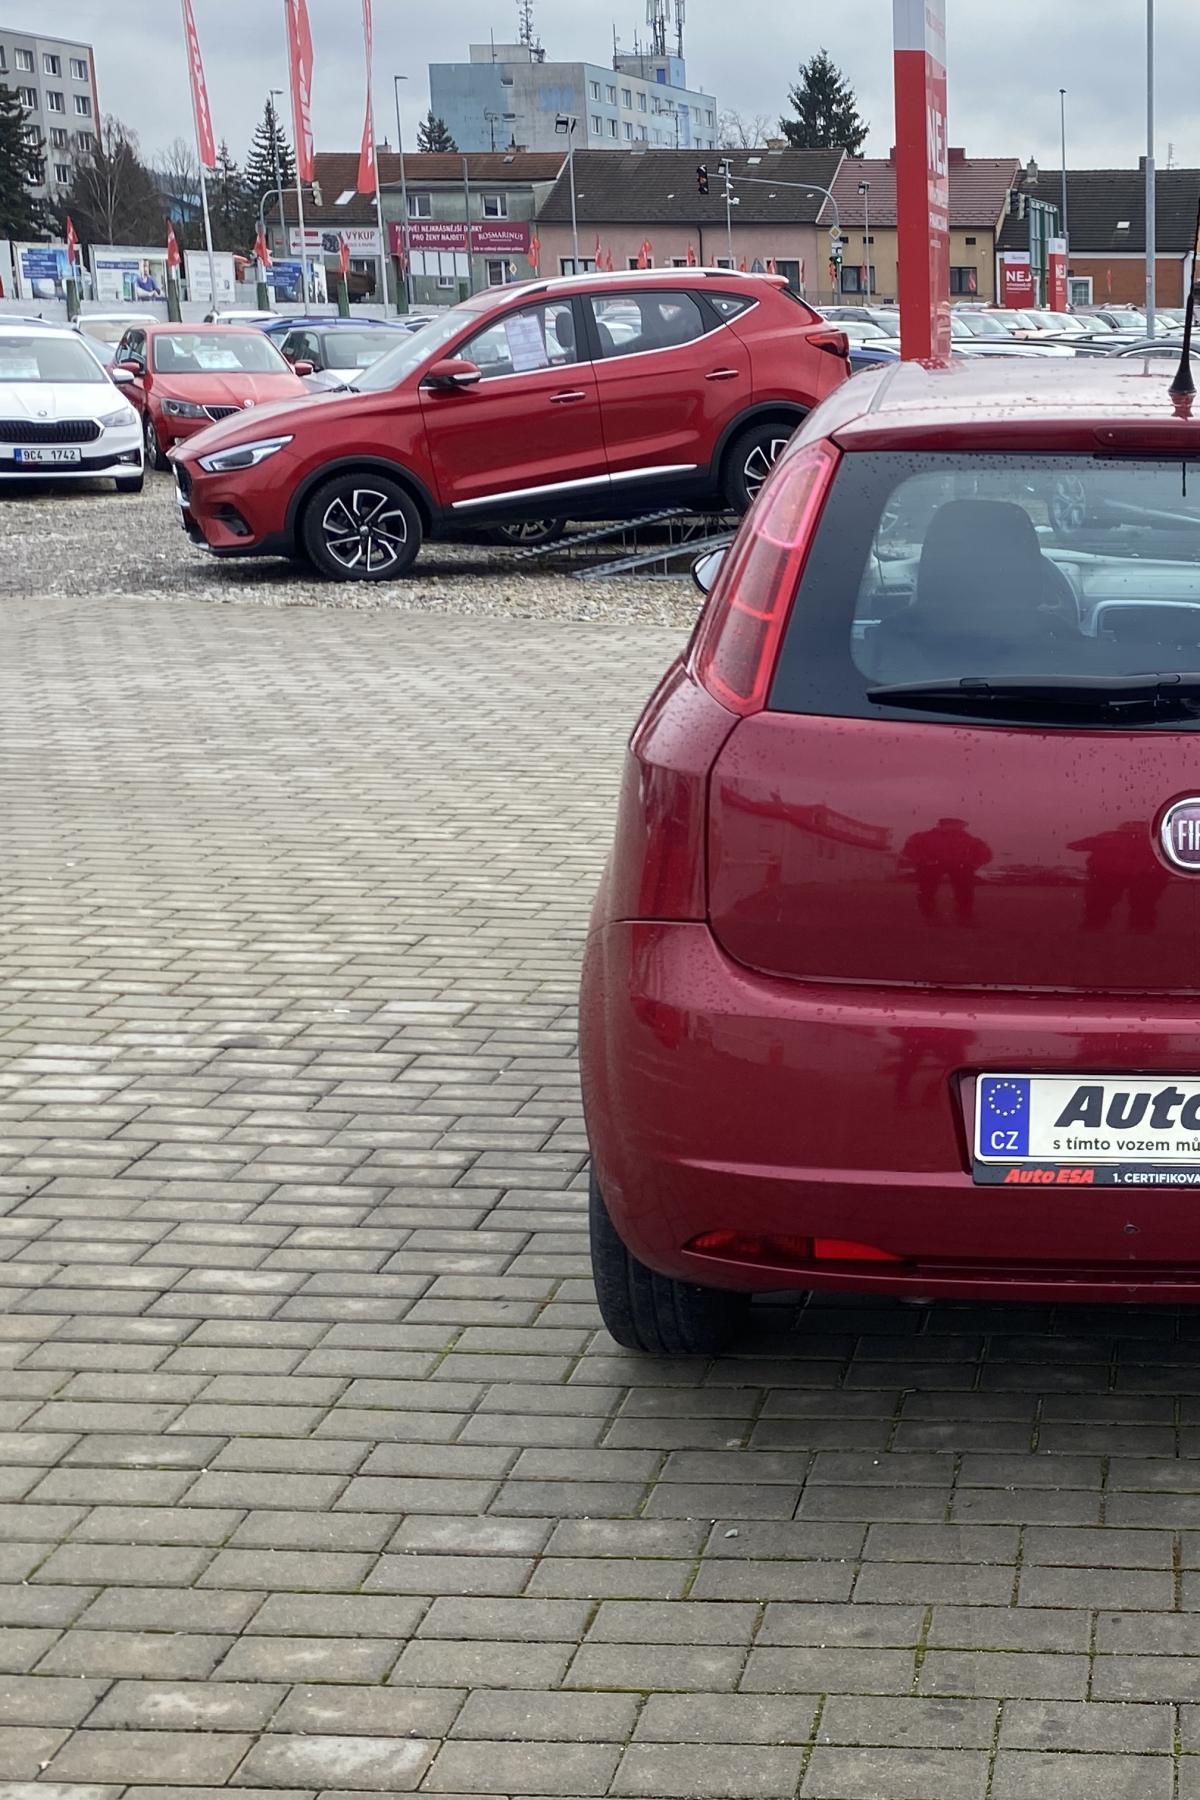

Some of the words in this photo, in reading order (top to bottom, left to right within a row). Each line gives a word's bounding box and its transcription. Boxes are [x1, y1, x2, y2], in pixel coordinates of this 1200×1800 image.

[464, 224, 482, 232] DRKY
[426, 233, 440, 241] ŽENY
[478, 232, 524, 241] ROSMARINUS
[1006, 270, 1031, 282] NEJ
[23, 450, 43, 460] 9C4
[51, 450, 76, 460] 1742
[991, 1131, 1018, 1150] CZ
[1053, 1139, 1061, 1150] s
[1066, 1136, 1111, 1150] tímto
[1116, 1139, 1170, 1151] vozem
[1004, 1168, 1056, 1183] Auto
[1056, 1169, 1094, 1183] ESA
[1113, 1173, 1122, 1183] 1.
